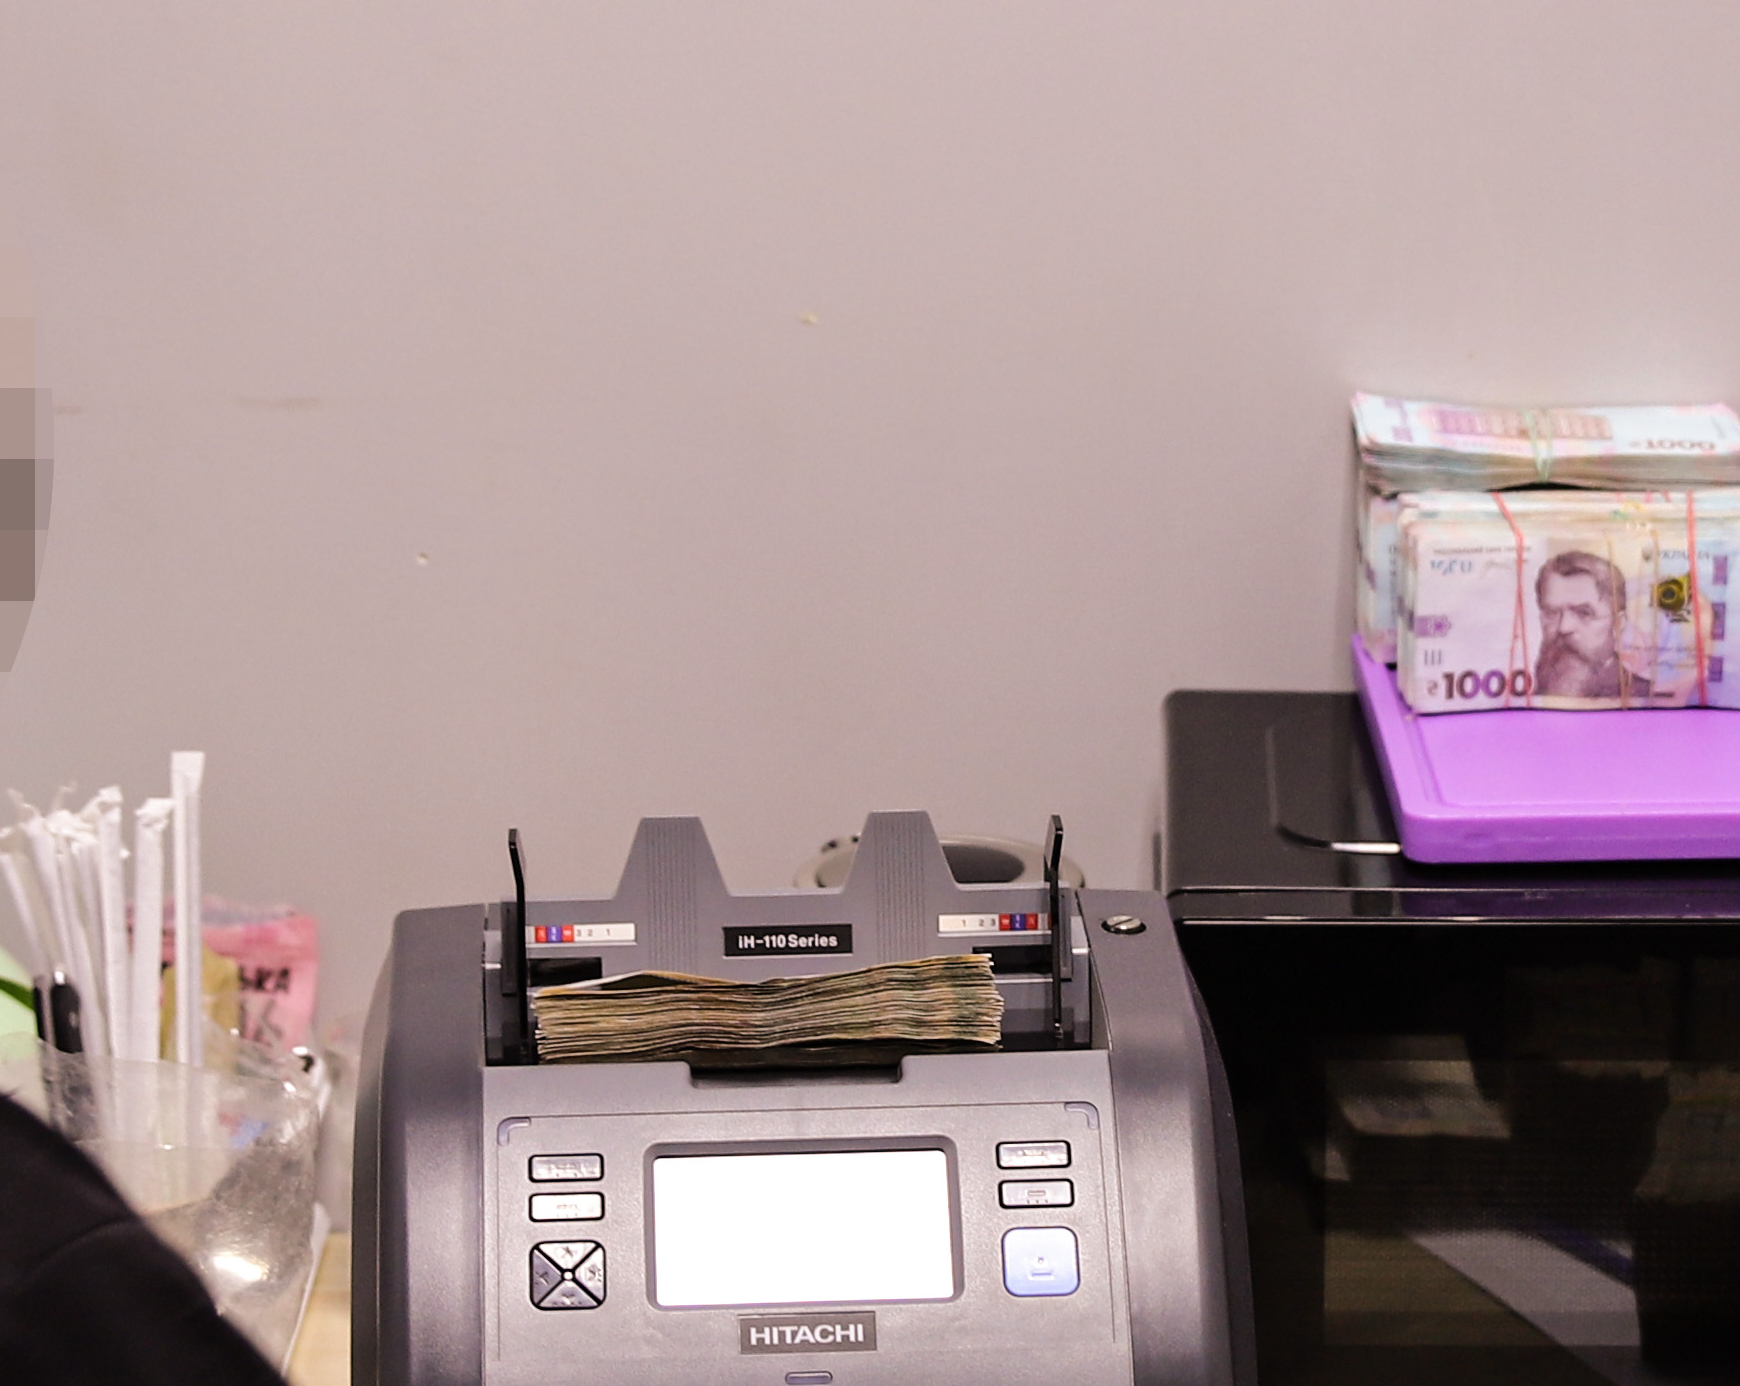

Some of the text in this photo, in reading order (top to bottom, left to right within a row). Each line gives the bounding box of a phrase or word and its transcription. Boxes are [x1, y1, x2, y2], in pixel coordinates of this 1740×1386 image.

[738, 933, 839, 949] iH-110 Series
[751, 1324, 863, 1344] HITACHI
